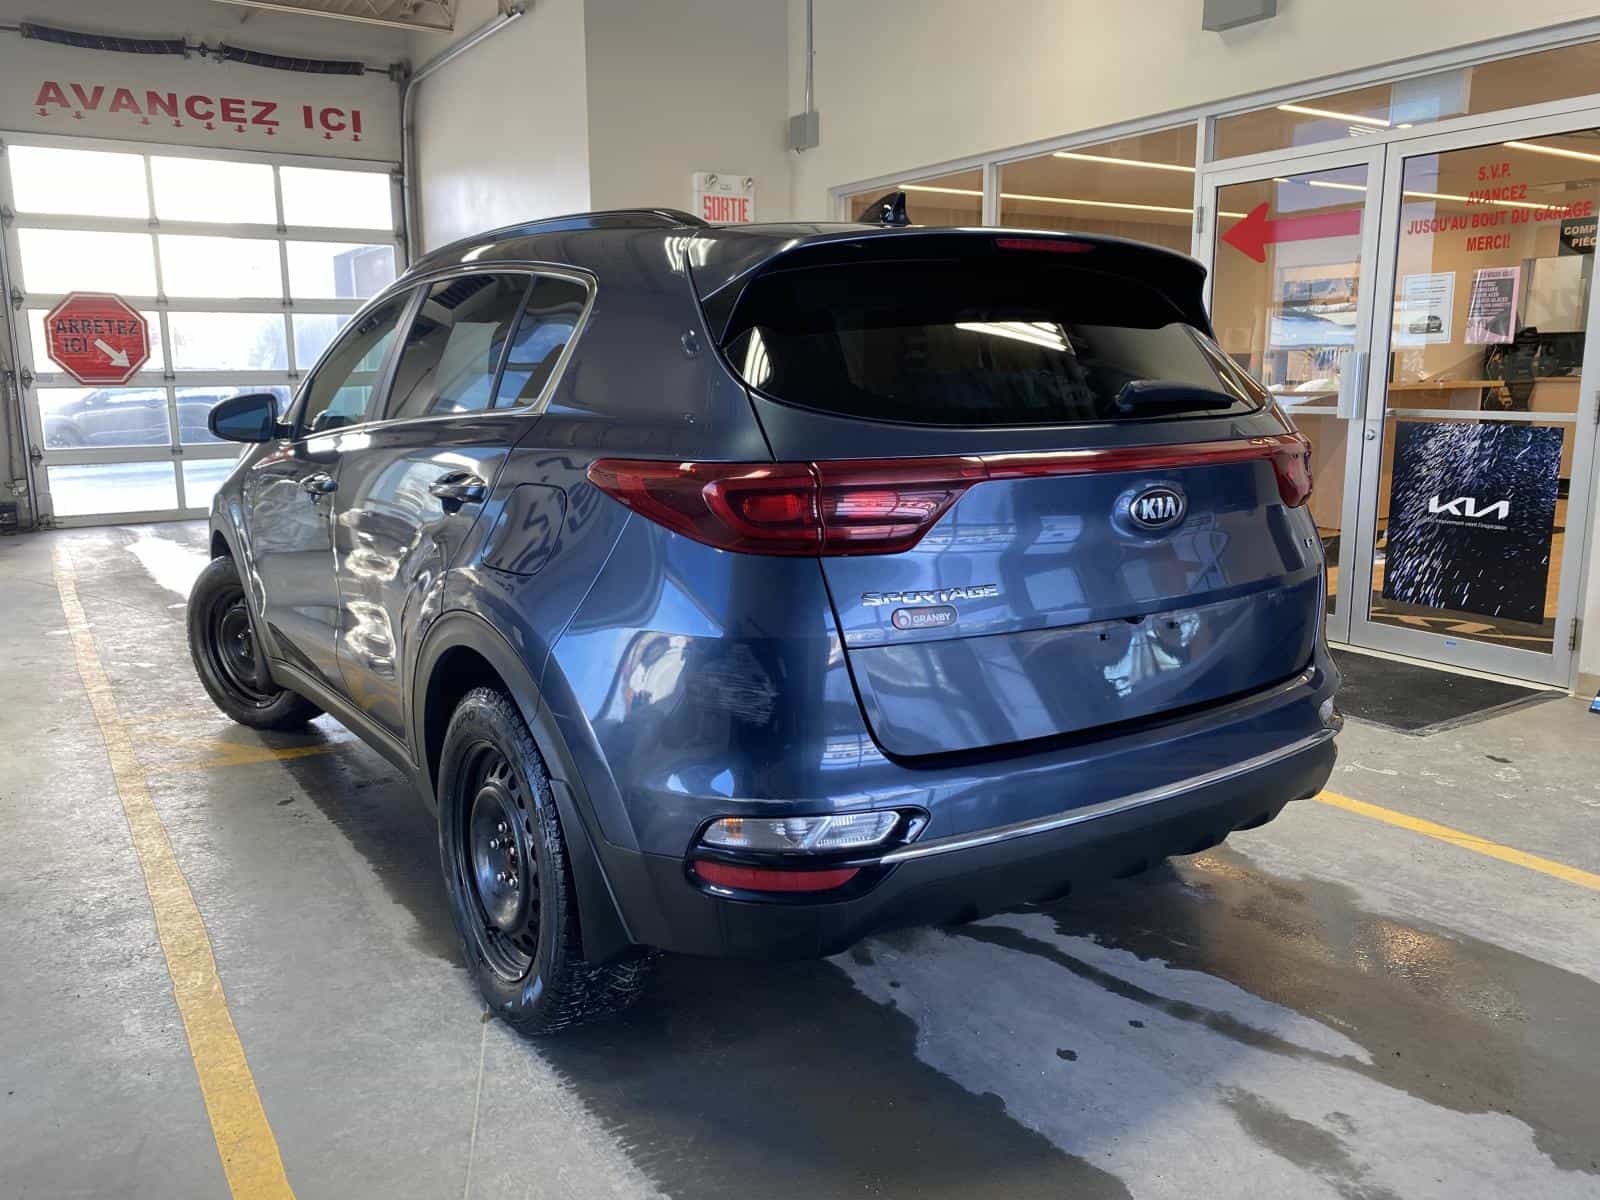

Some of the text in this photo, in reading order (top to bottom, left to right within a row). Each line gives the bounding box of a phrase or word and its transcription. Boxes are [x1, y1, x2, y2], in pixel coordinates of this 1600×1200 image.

[35, 81, 362, 133] AVANCEZ ICI
[1478, 164, 1511, 181] S.V.P.
[1467, 185, 1527, 207] AVANCEZ
[704, 195, 749, 223] SORTIE
[1407, 202, 1592, 235] JUSQU'AU BOUT DU GARAGE
[64, 338, 88, 352] ICI
[1141, 497, 1177, 520] KIA
[1429, 495, 1509, 519] KIA
[861, 584, 1000, 606] SPORTAGE
[912, 612, 951, 624] GRANBY
